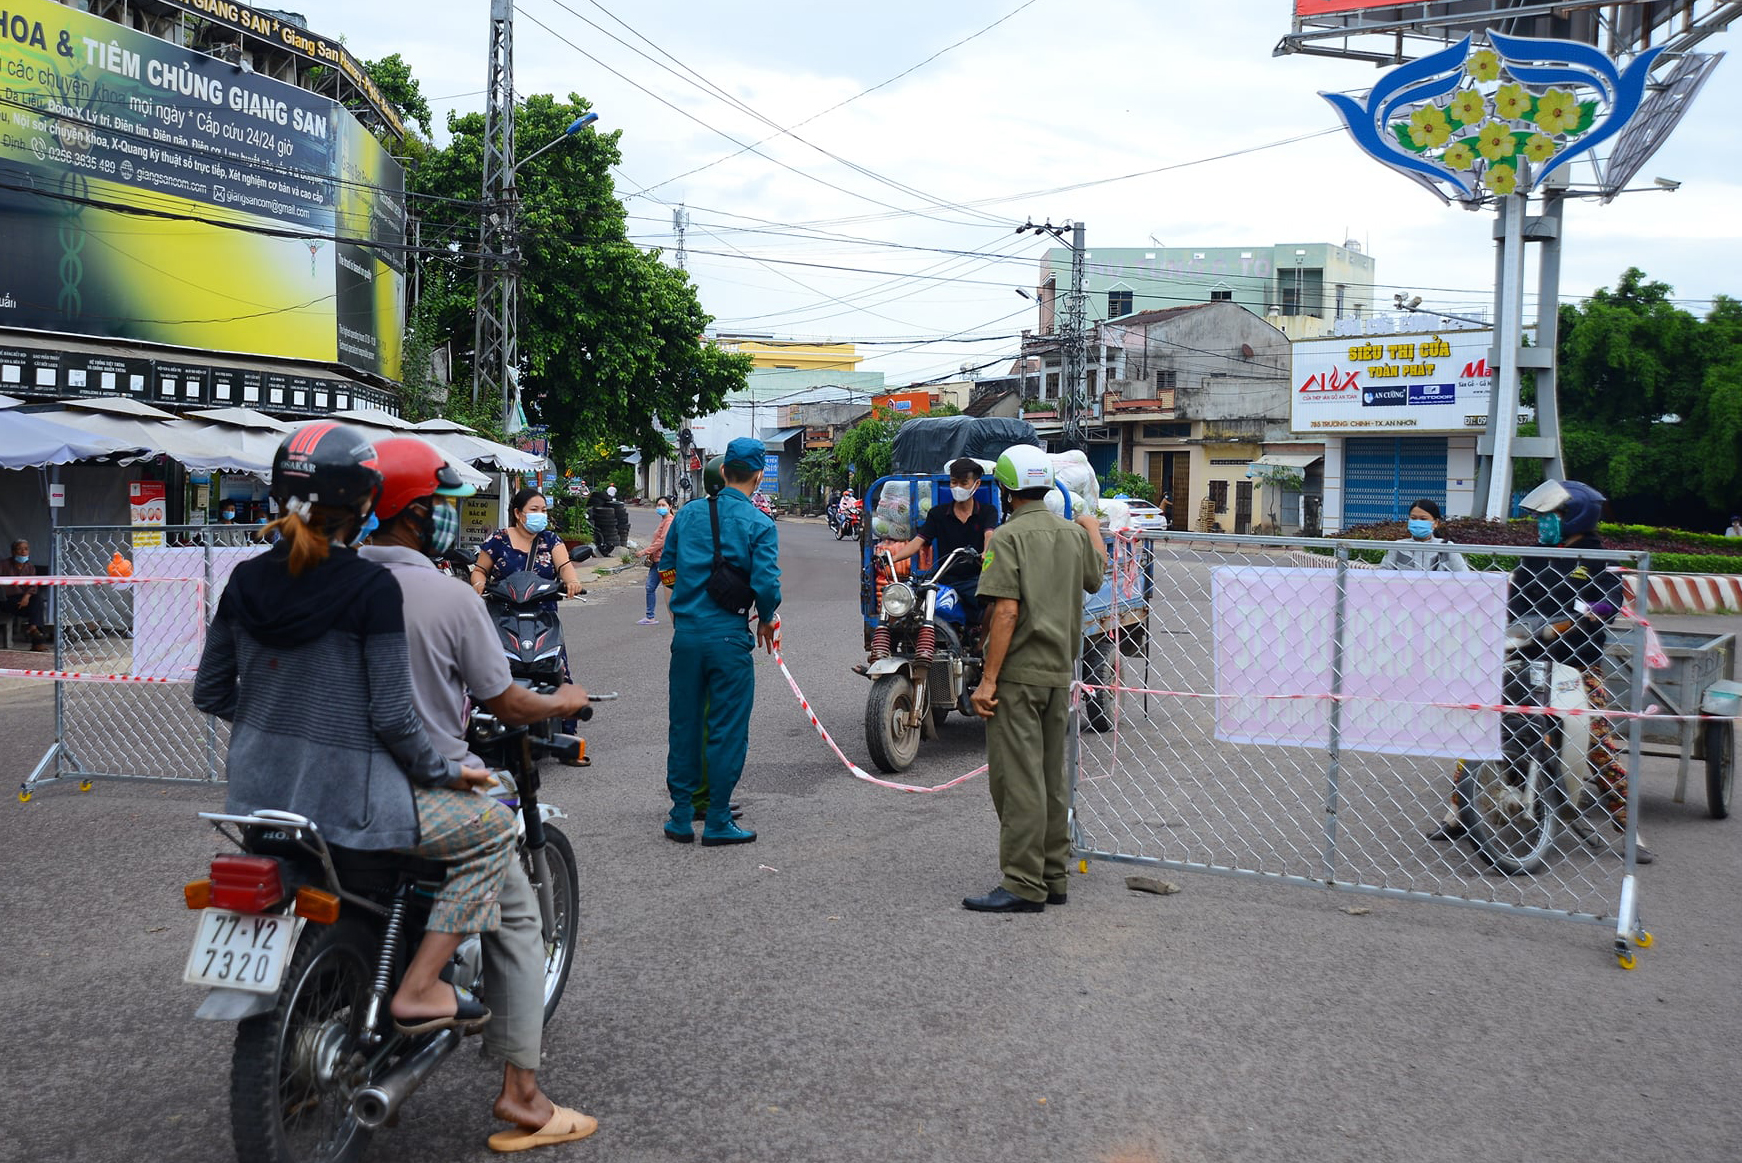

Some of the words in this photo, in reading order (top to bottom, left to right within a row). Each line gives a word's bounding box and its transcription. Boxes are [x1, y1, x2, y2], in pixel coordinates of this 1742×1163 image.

[191, 0, 239, 23] GIANG
[240, 9, 271, 37] SAN
[281, 27, 316, 57] Giang
[316, 40, 340, 64] San
[56, 28, 75, 60] &
[82, 37, 142, 81] TIÊM
[147, 60, 224, 107] CHỦNG
[228, 85, 289, 127] GIANG
[292, 107, 327, 140] SAN
[7, 57, 35, 81] các
[129, 94, 153, 118] mọi
[156, 101, 186, 130] ngày
[196, 111, 220, 138] Cấp
[222, 121, 244, 144] cứu
[246, 127, 276, 151] 24/24
[277, 137, 294, 159] giờ
[48, 121, 84, 144] chuyên
[85, 129, 110, 150] khoa,
[111, 137, 149, 161] X-Quang
[161, 150, 182, 169] thuật
[300, 189, 312, 201] cao
[99, 159, 117, 175] 489
[1387, 343, 1415, 364] THỊ
[1419, 334, 1451, 358] CỬA
[1368, 362, 1399, 379] TOÀN
[1402, 360, 1436, 378] PHÁT
[1375, 391, 1383, 399] AN
[211, 914, 279, 950] 77-Y2
[201, 948, 270, 983] 7320
